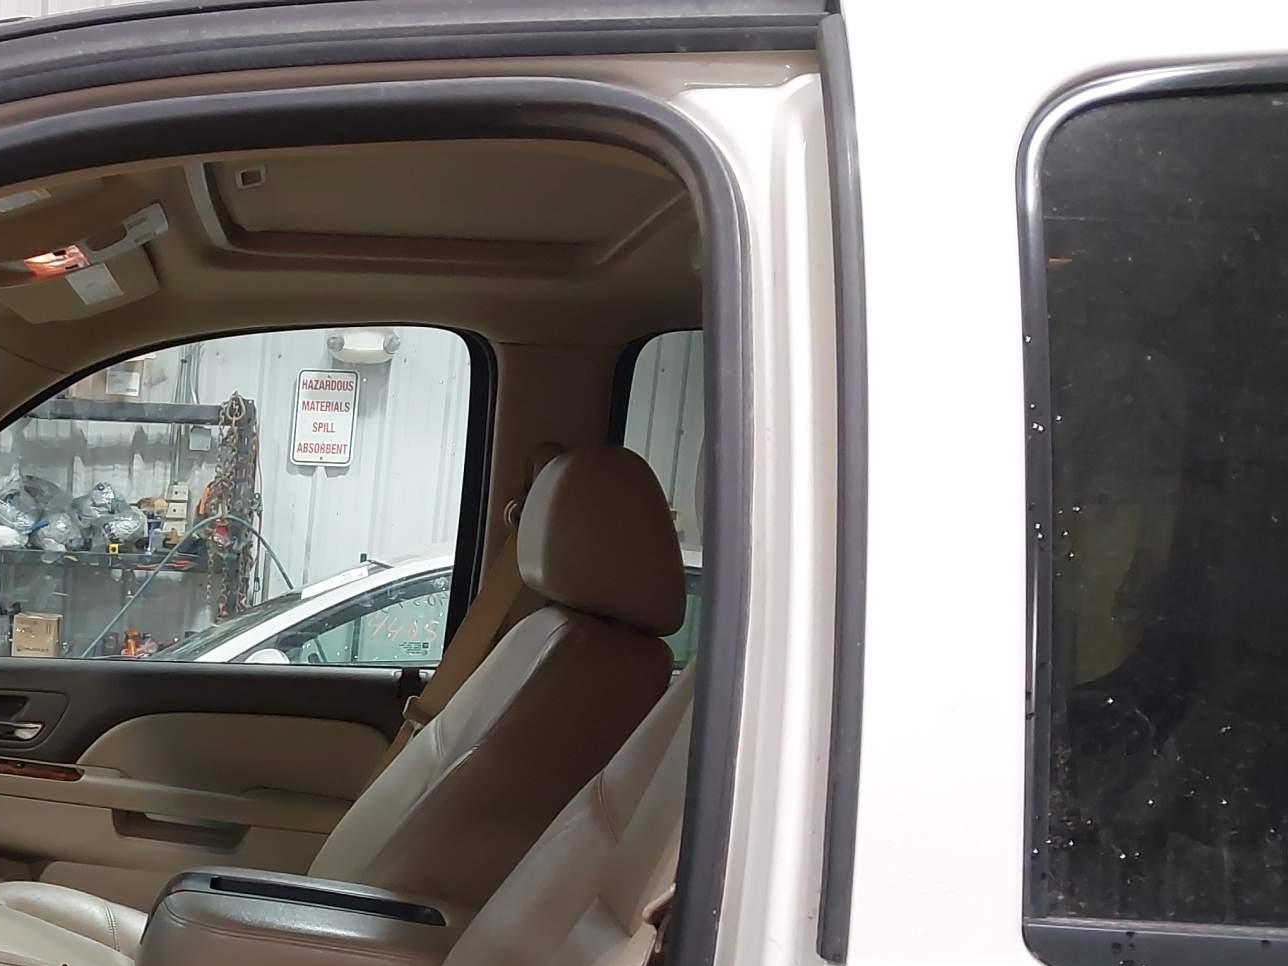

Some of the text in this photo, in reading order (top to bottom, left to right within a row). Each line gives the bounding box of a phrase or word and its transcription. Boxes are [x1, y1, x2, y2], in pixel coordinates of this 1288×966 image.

[302, 379, 354, 391] HAZARDOUS
[301, 400, 350, 412] MATERIALS
[312, 422, 336, 433] SPILL
[296, 443, 348, 455] ABSORBENT
